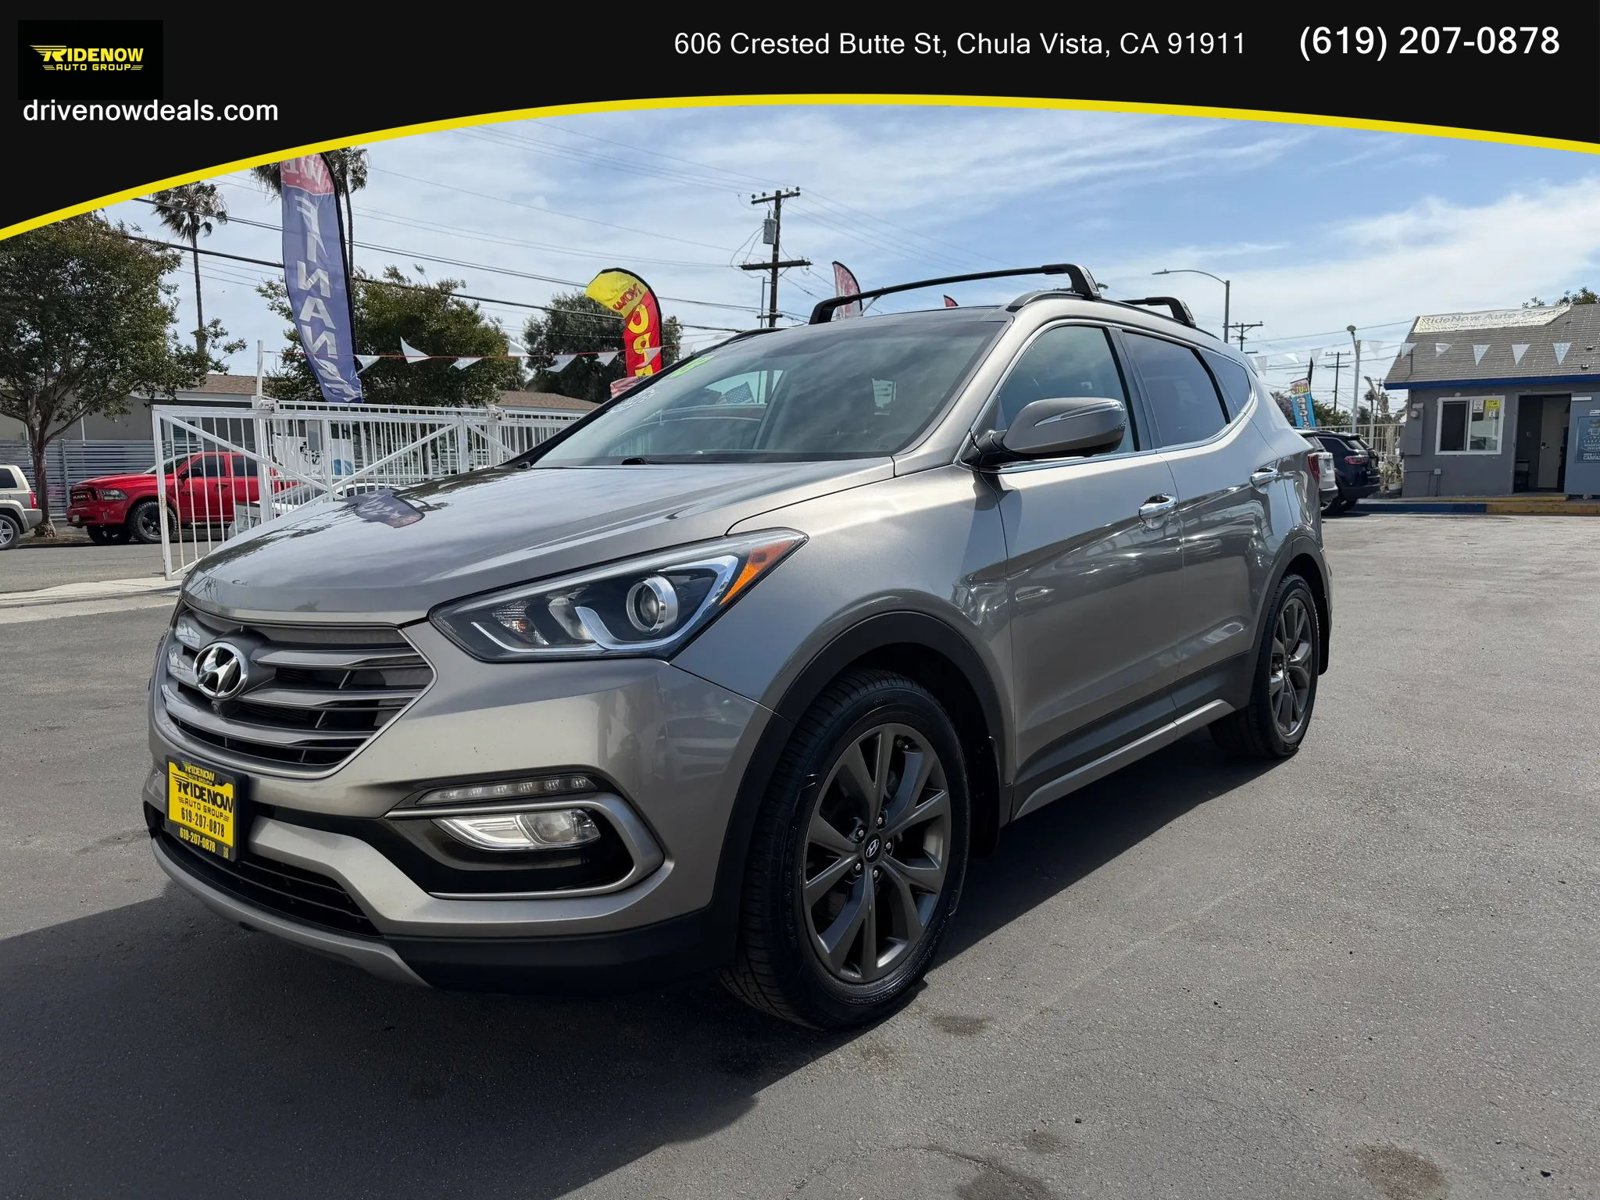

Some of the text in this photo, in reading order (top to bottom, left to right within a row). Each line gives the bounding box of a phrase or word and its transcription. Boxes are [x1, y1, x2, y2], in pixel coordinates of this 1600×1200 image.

[172, 773, 233, 813] RIDENOW
[184, 798, 223, 819] AUTO GROUP
[181, 807, 225, 838] 619-207-0878
